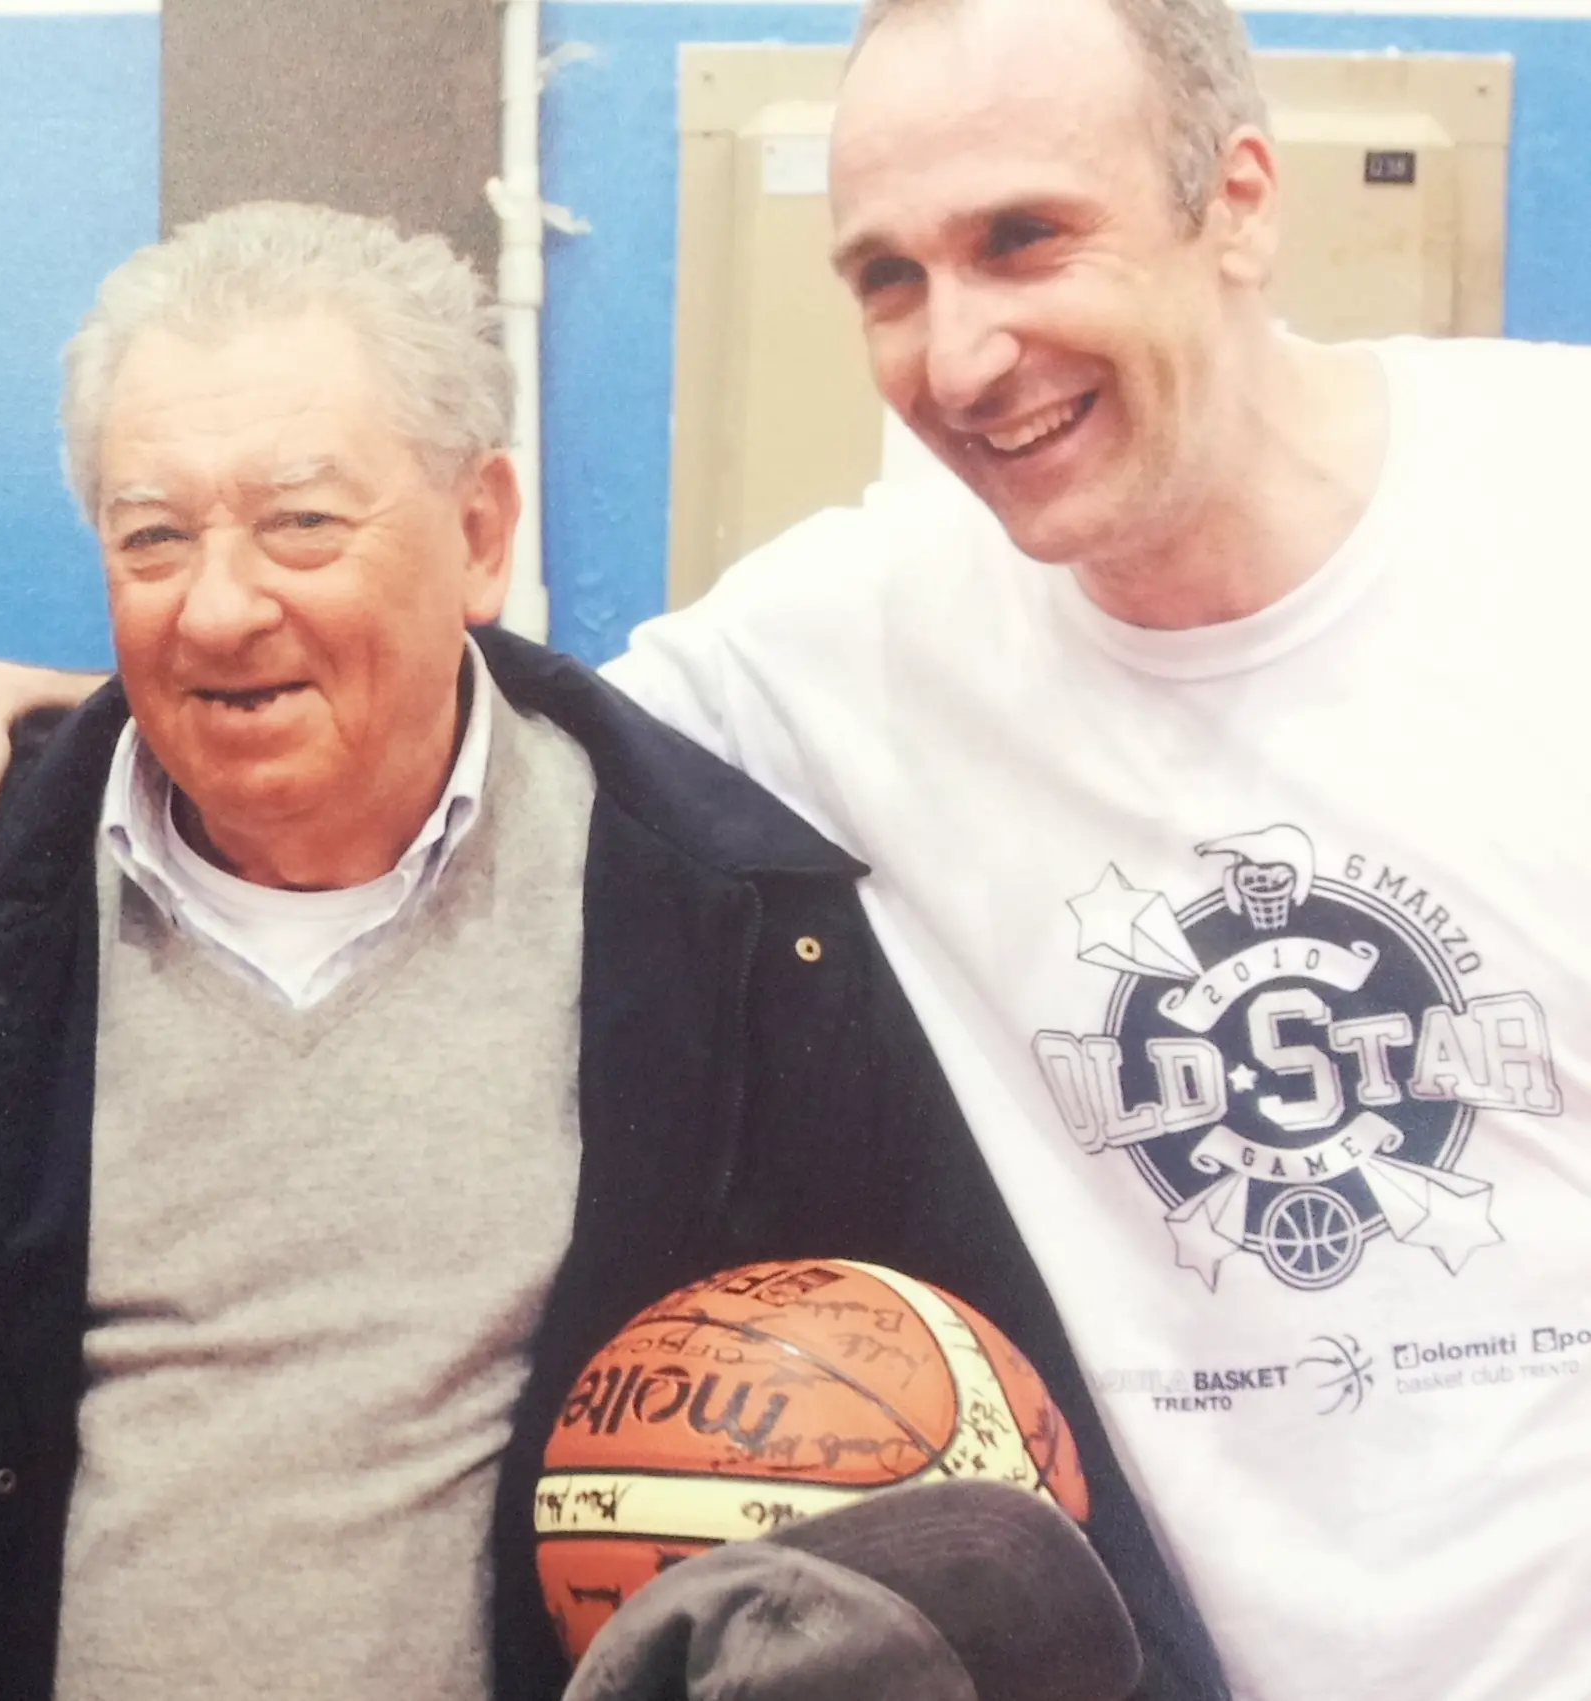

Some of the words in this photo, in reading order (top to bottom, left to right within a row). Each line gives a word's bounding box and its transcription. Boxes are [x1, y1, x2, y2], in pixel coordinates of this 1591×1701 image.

[1342, 853, 1367, 881] 6
[1373, 866, 1483, 976] MARZO
[1202, 945, 1321, 1005] 2010
[1031, 1029, 1228, 1155] OLD
[1247, 988, 1563, 1131] STAR
[1240, 1135, 1363, 1177] GAME
[1152, 1395, 1233, 1412] TRENTO
[1192, 1365, 1290, 1393] BASKET
